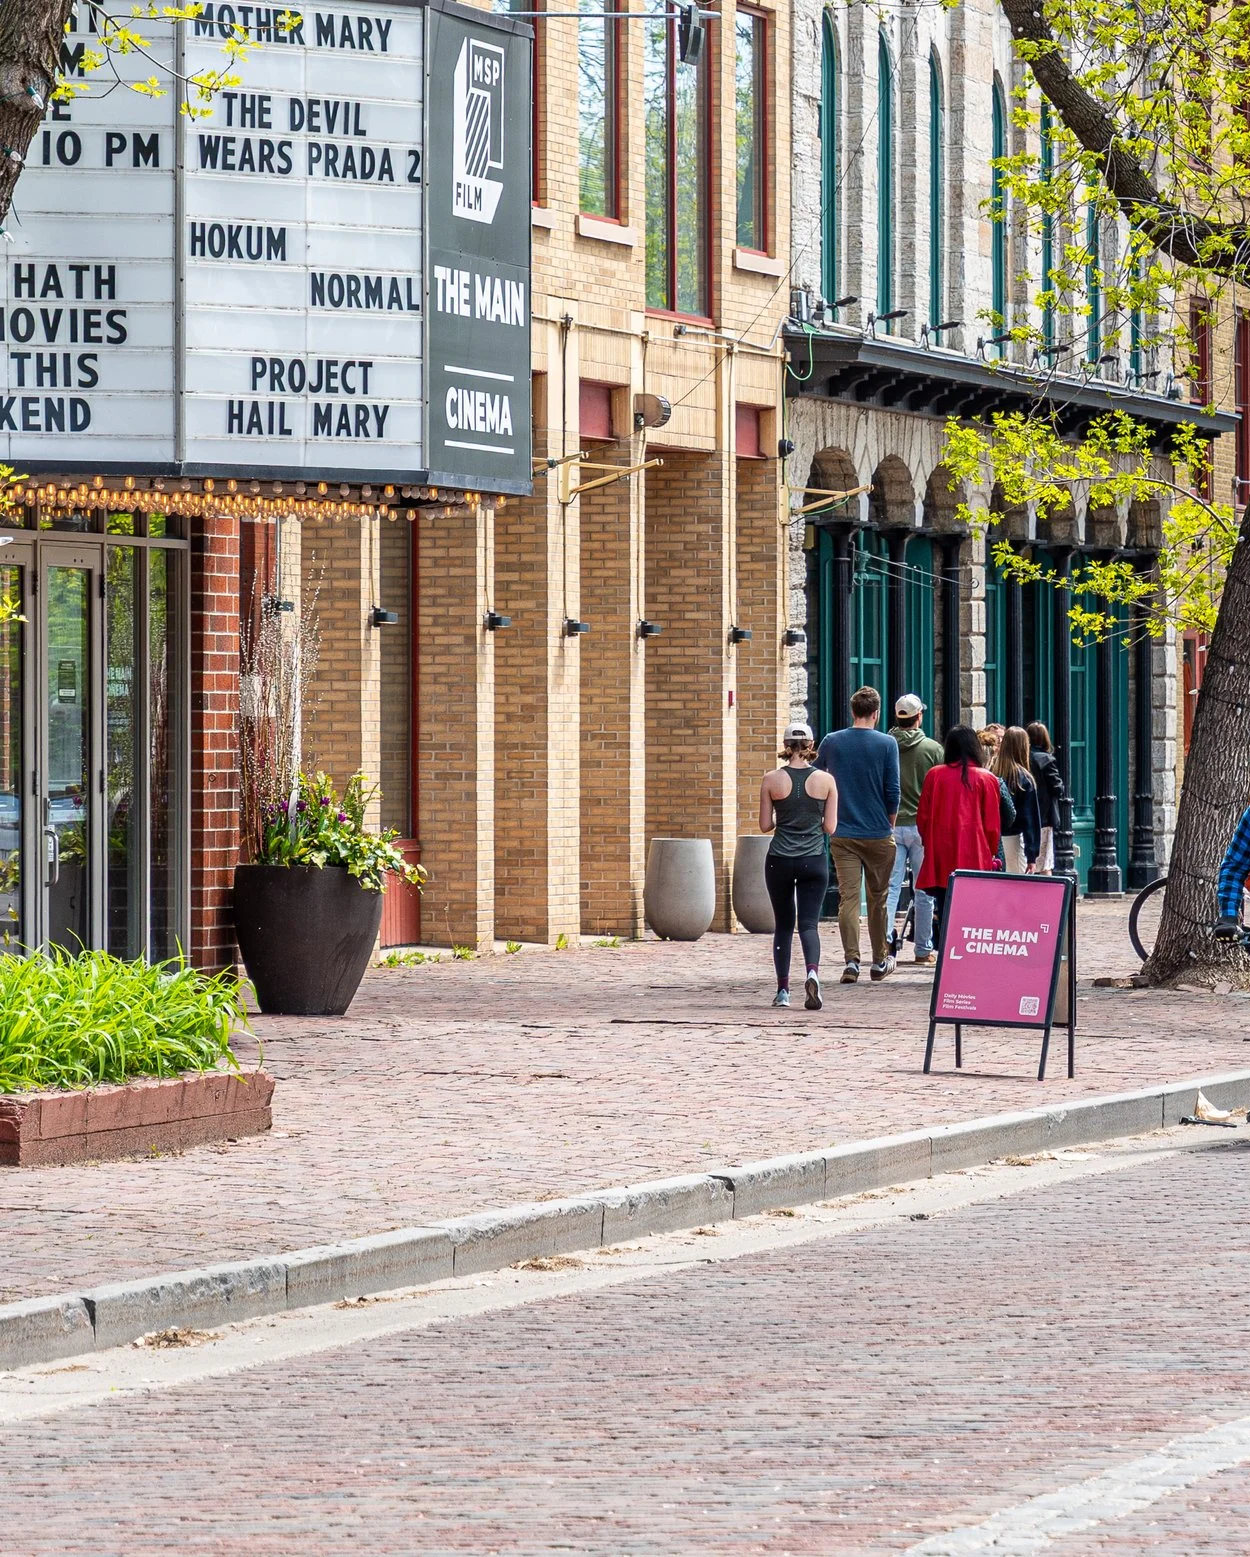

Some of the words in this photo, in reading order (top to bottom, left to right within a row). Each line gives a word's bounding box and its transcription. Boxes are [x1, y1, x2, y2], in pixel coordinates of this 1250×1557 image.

[194, 2, 305, 45] MOTHER
[315, 12, 393, 52] MARY
[473, 54, 500, 87] MSP
[222, 92, 272, 130] THE
[289, 97, 367, 137] DEVIL
[105, 132, 160, 168] PM
[199, 134, 293, 175] WEARS
[308, 142, 395, 182] PRADA
[407, 149, 421, 183] 2
[455, 181, 482, 212] FILM
[190, 221, 287, 262] HOKUM
[14, 263, 116, 300] HATH
[311, 272, 420, 311] NORMAL
[434, 264, 471, 317] THE
[474, 273, 525, 327] MAIN
[0, 306, 128, 345] OVIES
[10, 351, 99, 389] THIS
[251, 356, 373, 395] PROJECT
[227, 399, 293, 437] HAIL
[313, 402, 390, 439] MARY
[445, 386, 513, 436] CINEMA
[961, 927, 993, 940] THE
[996, 929, 1039, 944] MAIN
[965, 942, 1028, 956] CINEMA
